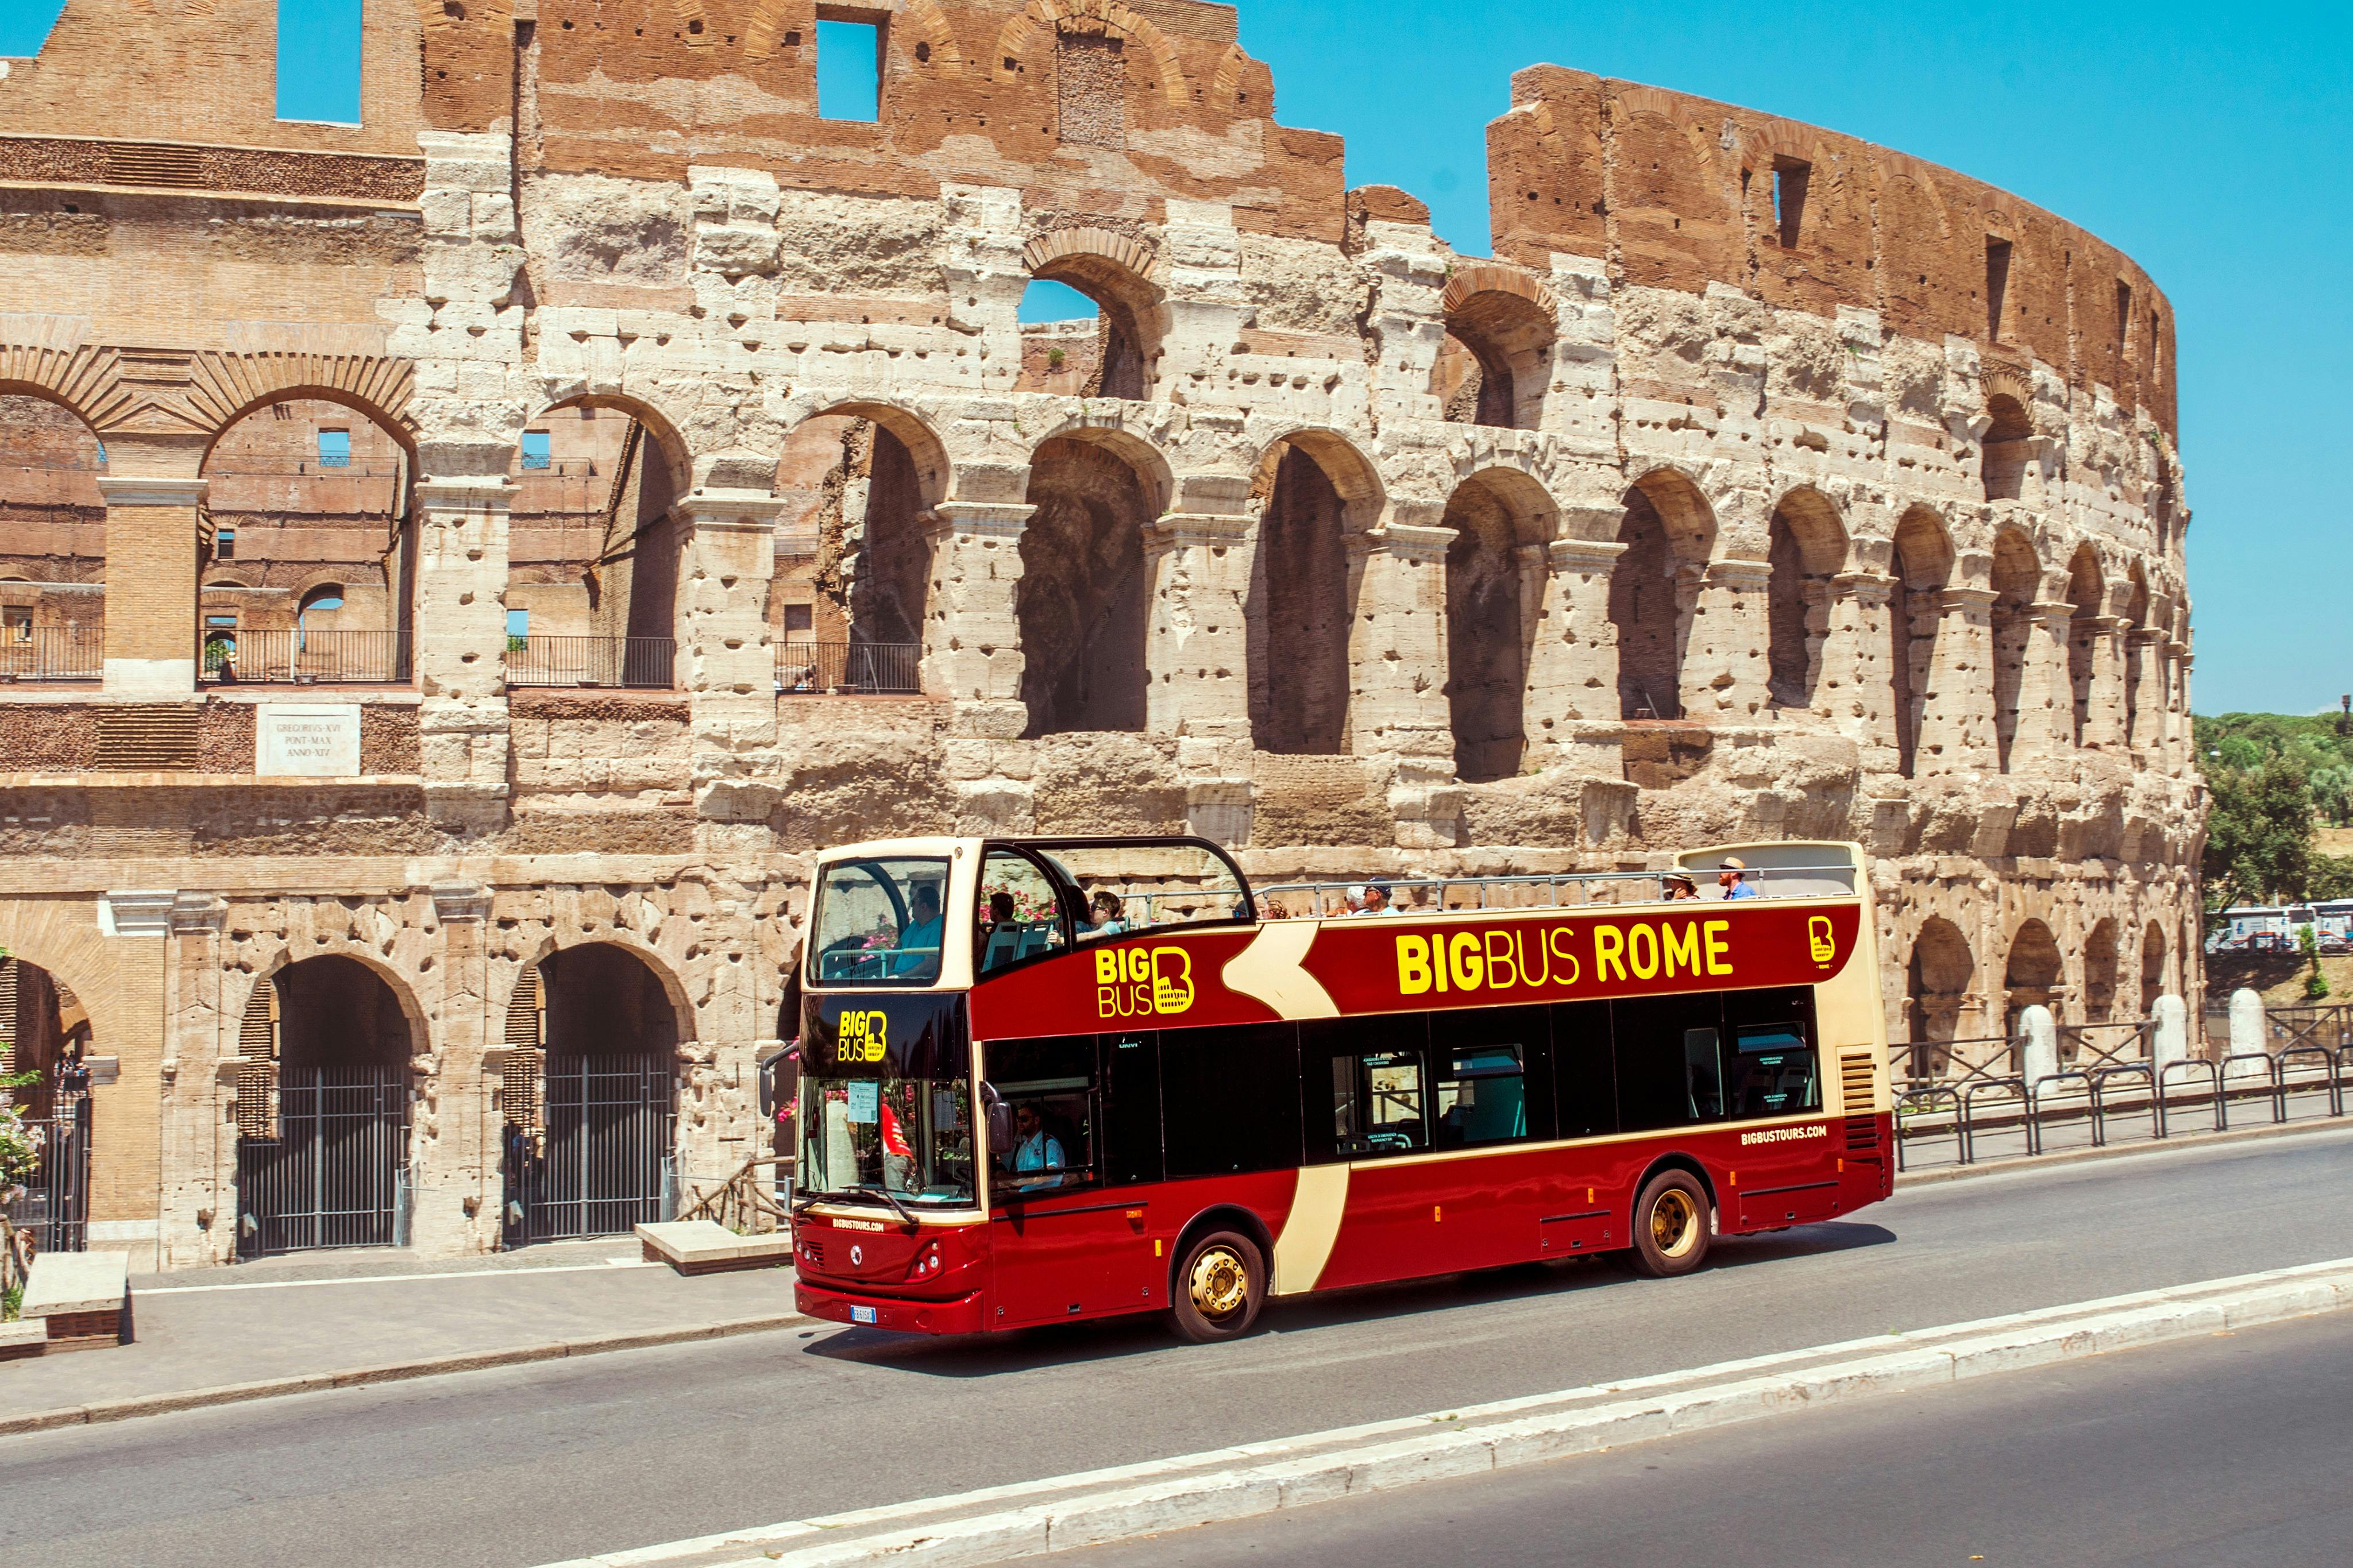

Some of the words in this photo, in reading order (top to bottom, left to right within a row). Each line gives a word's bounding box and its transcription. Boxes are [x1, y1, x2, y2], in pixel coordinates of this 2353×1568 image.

[1594, 920, 1734, 982] ROME
[1095, 948, 1150, 984] BIG
[1098, 984, 1152, 1018] BUS
[839, 1011, 866, 1037] BIG
[838, 1038, 864, 1061] BUS
[1741, 1125, 1827, 1145] BIGBUSTOURS.COM
[832, 1218, 884, 1232] BIGBUSTOURS.COM
